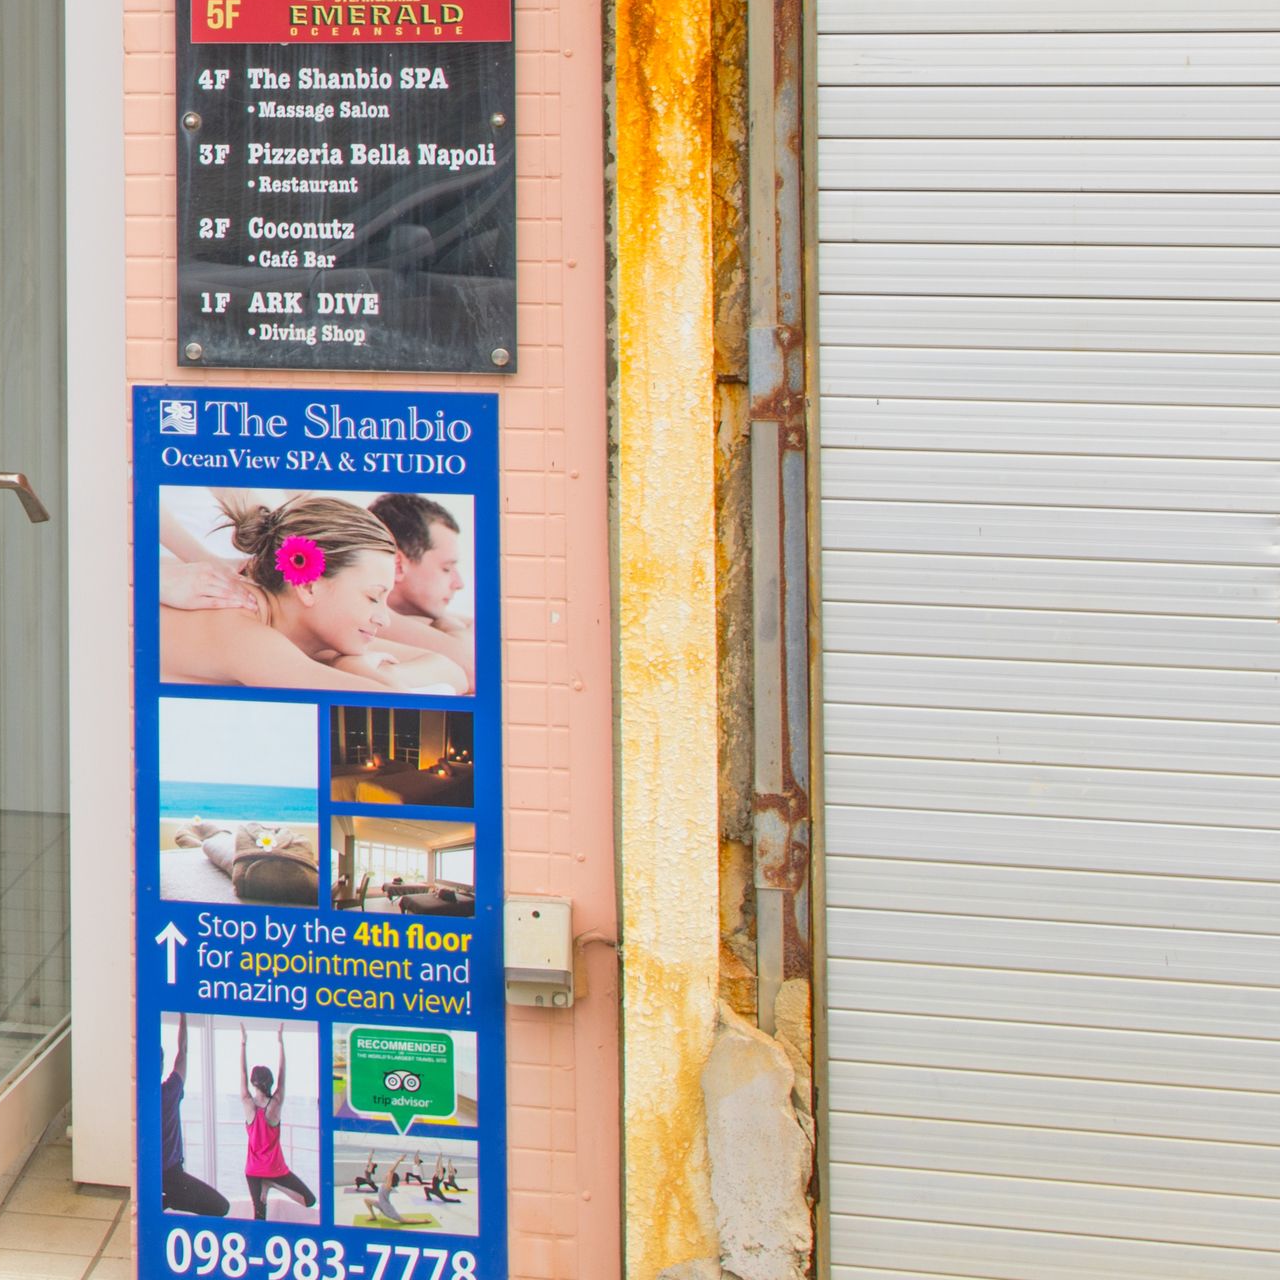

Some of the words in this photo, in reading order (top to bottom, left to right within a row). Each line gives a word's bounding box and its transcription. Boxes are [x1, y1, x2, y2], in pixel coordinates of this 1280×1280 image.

[206, 0, 241, 29] 5F
[289, 4, 465, 26] EMERALD
[290, 26, 464, 36] OCEANSIDE
[198, 69, 230, 90] 4F
[247, 68, 290, 90] The
[298, 67, 393, 90] Shanbio
[400, 67, 448, 90] SPA
[258, 102, 337, 122] Massage
[339, 102, 389, 119] Salon
[199, 144, 230, 165] 3F
[248, 143, 343, 165] Pizzeria
[350, 143, 410, 165] Bella
[418, 143, 497, 171] Napoli
[258, 177, 358, 193] Restaurant
[199, 219, 230, 239] 2F
[249, 217, 355, 240] Coconutz
[259, 250, 298, 269] Café
[303, 251, 337, 269] Bar
[201, 293, 230, 313] 1F
[248, 292, 303, 314] ARK
[318, 292, 380, 315] DIVE
[259, 324, 318, 345] Diving
[321, 325, 365, 345] Shop
[204, 400, 288, 438] The
[303, 402, 473, 443] Shanbio
[286, 450, 332, 472] SPA
[338, 452, 357, 472] &
[363, 452, 467, 475] STUDIO
[197, 912, 257, 945] Stop
[264, 915, 296, 948] by
[302, 917, 346, 945] the
[353, 921, 400, 948] 4th
[406, 923, 472, 952] floor
[197, 943, 233, 969] for
[239, 950, 412, 980] appointment
[419, 958, 470, 984] and
[197, 978, 308, 1010] amazing
[315, 986, 395, 1010] ocean
[403, 988, 472, 1015] view!
[356, 1039, 447, 1053] RECOMMENDED
[372, 1094, 431, 1108] tripadvisor
[166, 1227, 477, 1280] 098-983-7778
